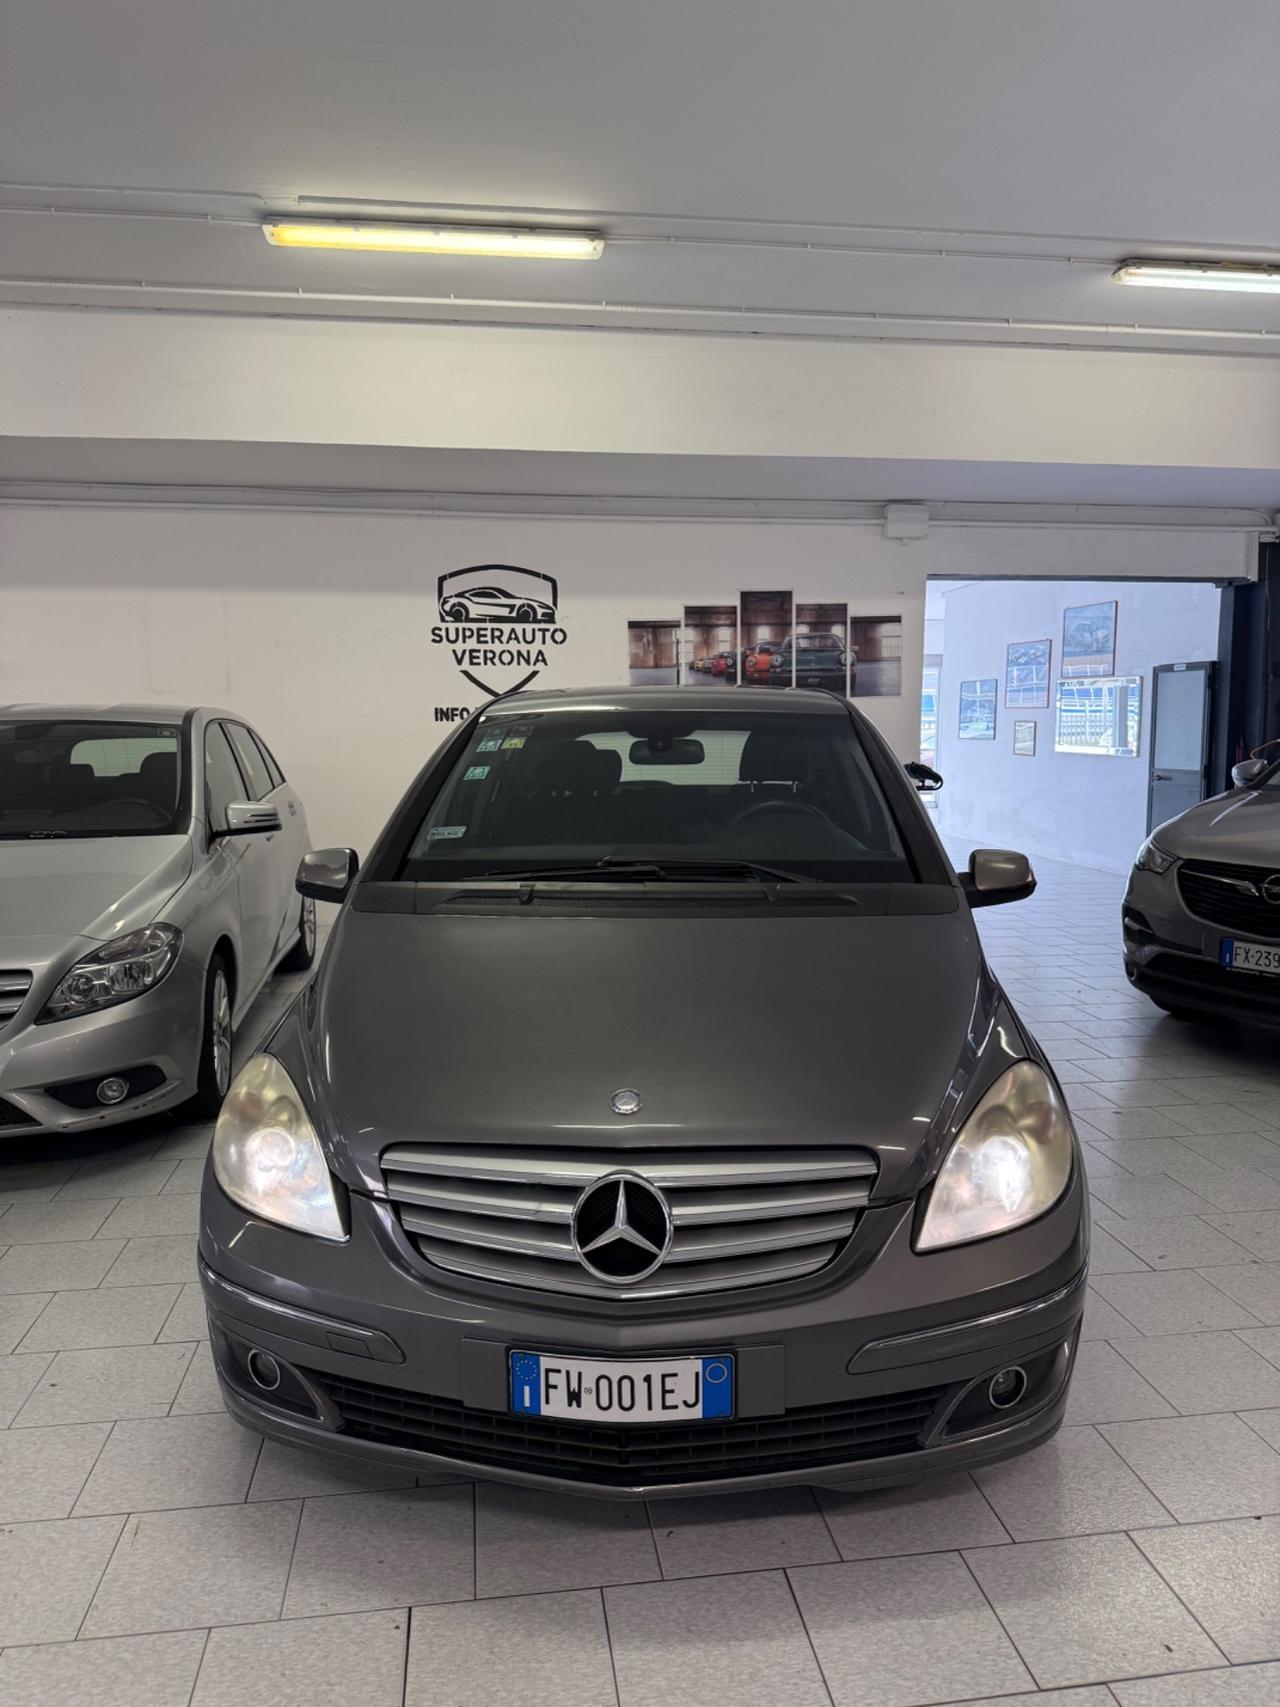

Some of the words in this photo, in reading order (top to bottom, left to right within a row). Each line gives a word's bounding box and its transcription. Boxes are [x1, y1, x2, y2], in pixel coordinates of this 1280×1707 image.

[431, 626, 567, 645] SUPERAUTO
[452, 649, 548, 666] VERONA
[434, 706, 470, 722] INFO
